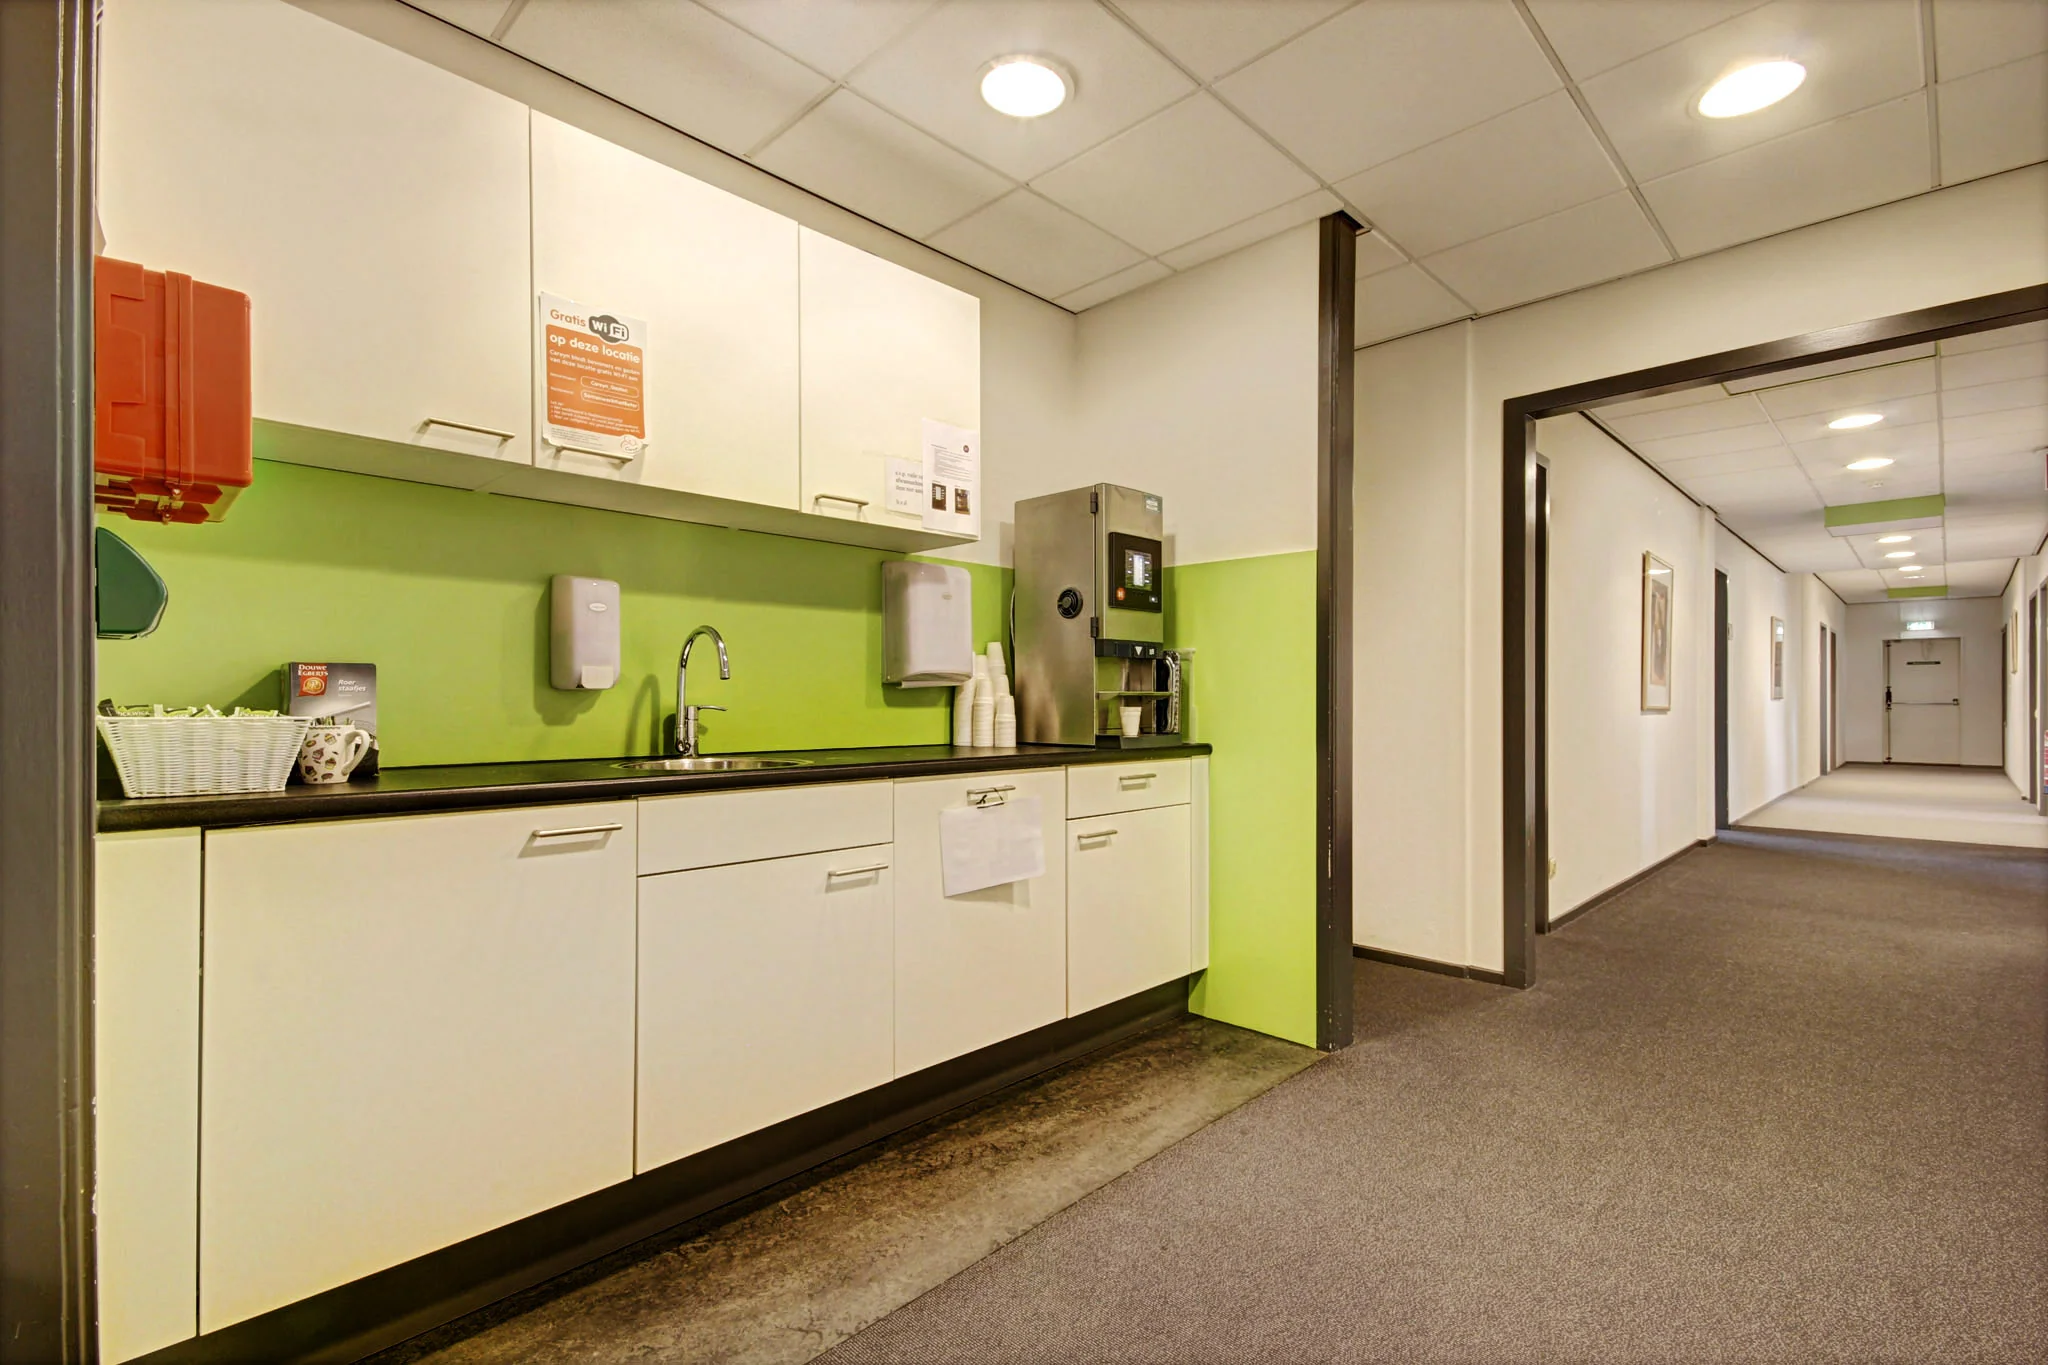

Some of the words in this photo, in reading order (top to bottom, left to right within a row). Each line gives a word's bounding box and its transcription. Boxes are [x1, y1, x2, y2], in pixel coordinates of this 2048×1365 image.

[550, 309, 586, 327] Gratis
[549, 334, 566, 347] op
[570, 337, 599, 353] deze
[602, 344, 640, 364] locatie
[338, 685, 367, 693] staafjes
